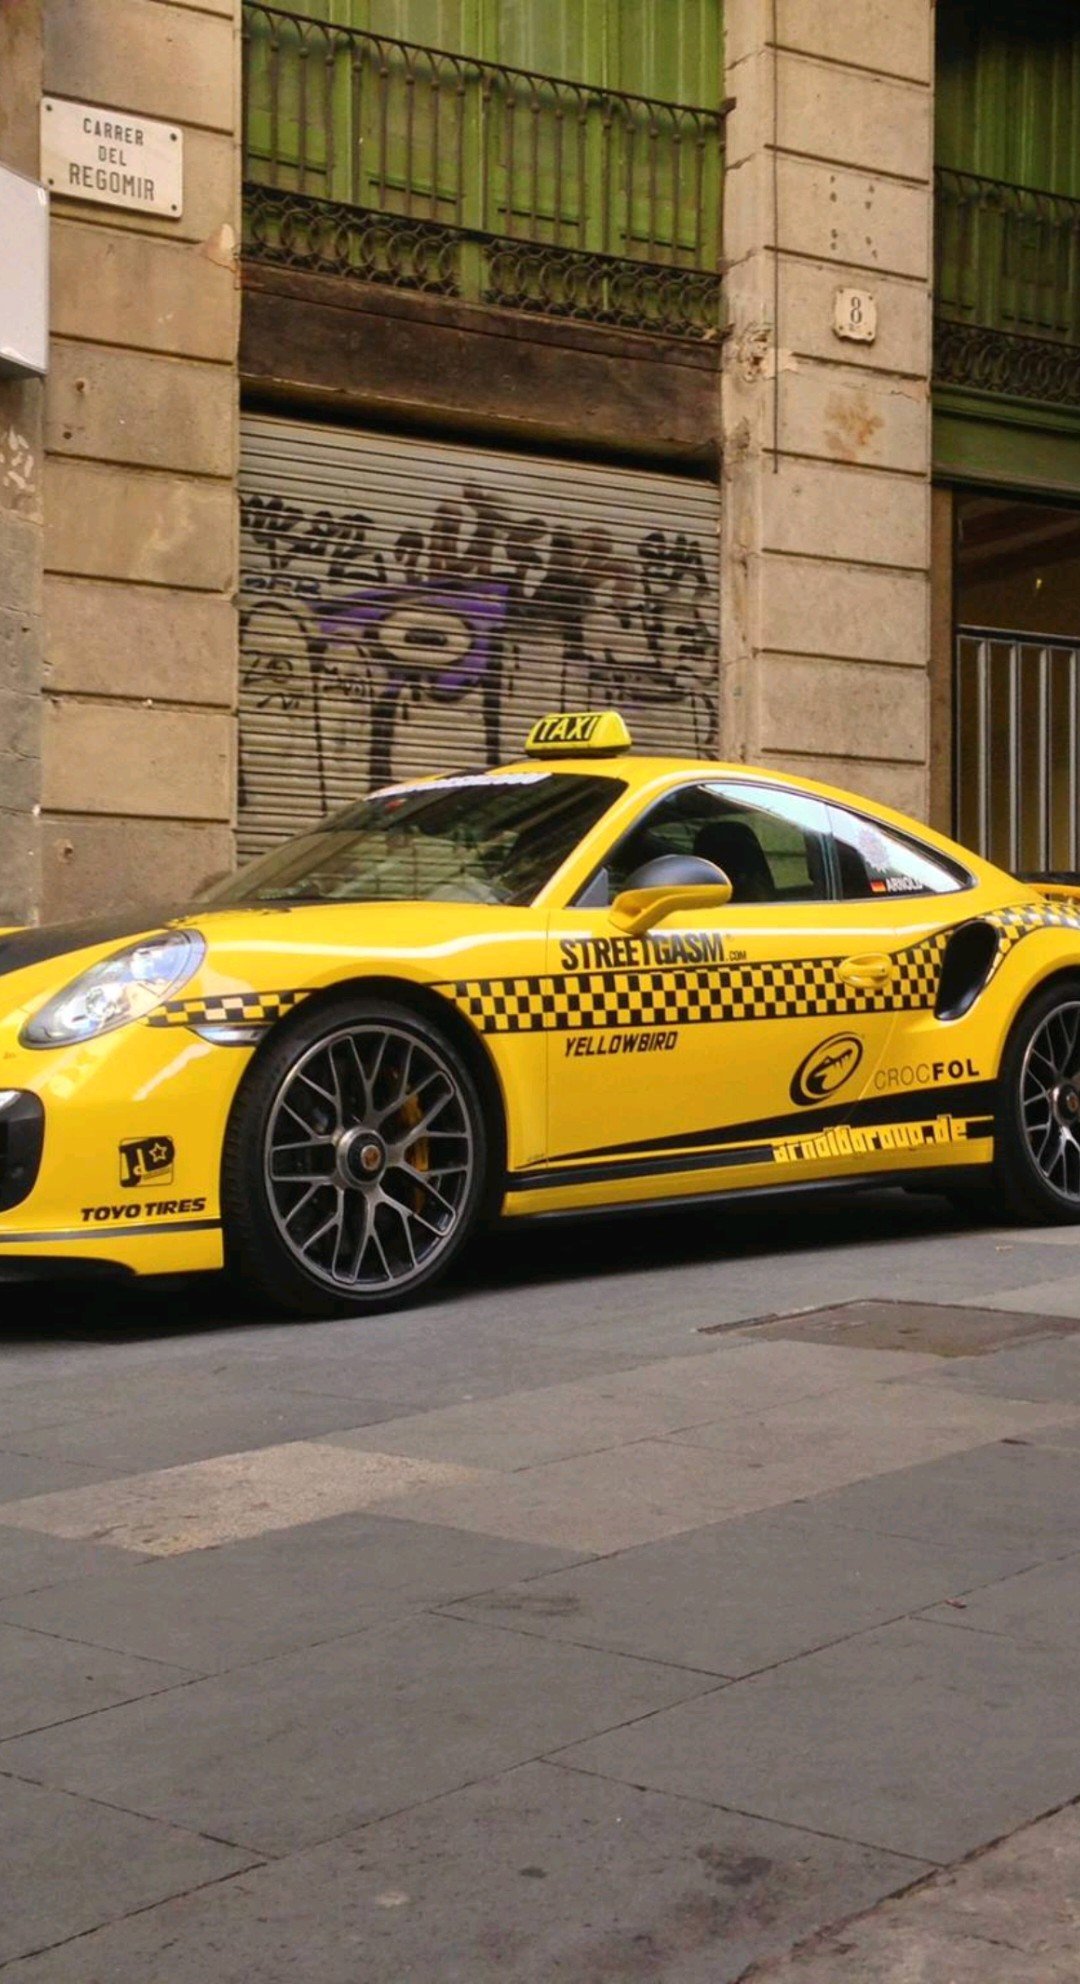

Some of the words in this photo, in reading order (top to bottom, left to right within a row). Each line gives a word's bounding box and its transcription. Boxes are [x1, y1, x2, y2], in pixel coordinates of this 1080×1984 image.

[83, 117, 144, 146] CARRER
[97, 145, 128, 167] DEL
[68, 162, 155, 201] REGOMIR
[850, 296, 863, 324] 8
[538, 716, 600, 741] TAXI
[564, 1031, 679, 1057] YELLOWBIRD
[873, 1058, 981, 1092] CROCFOL
[81, 1203, 142, 1222] TOYO
[144, 1197, 207, 1217] TIRES
